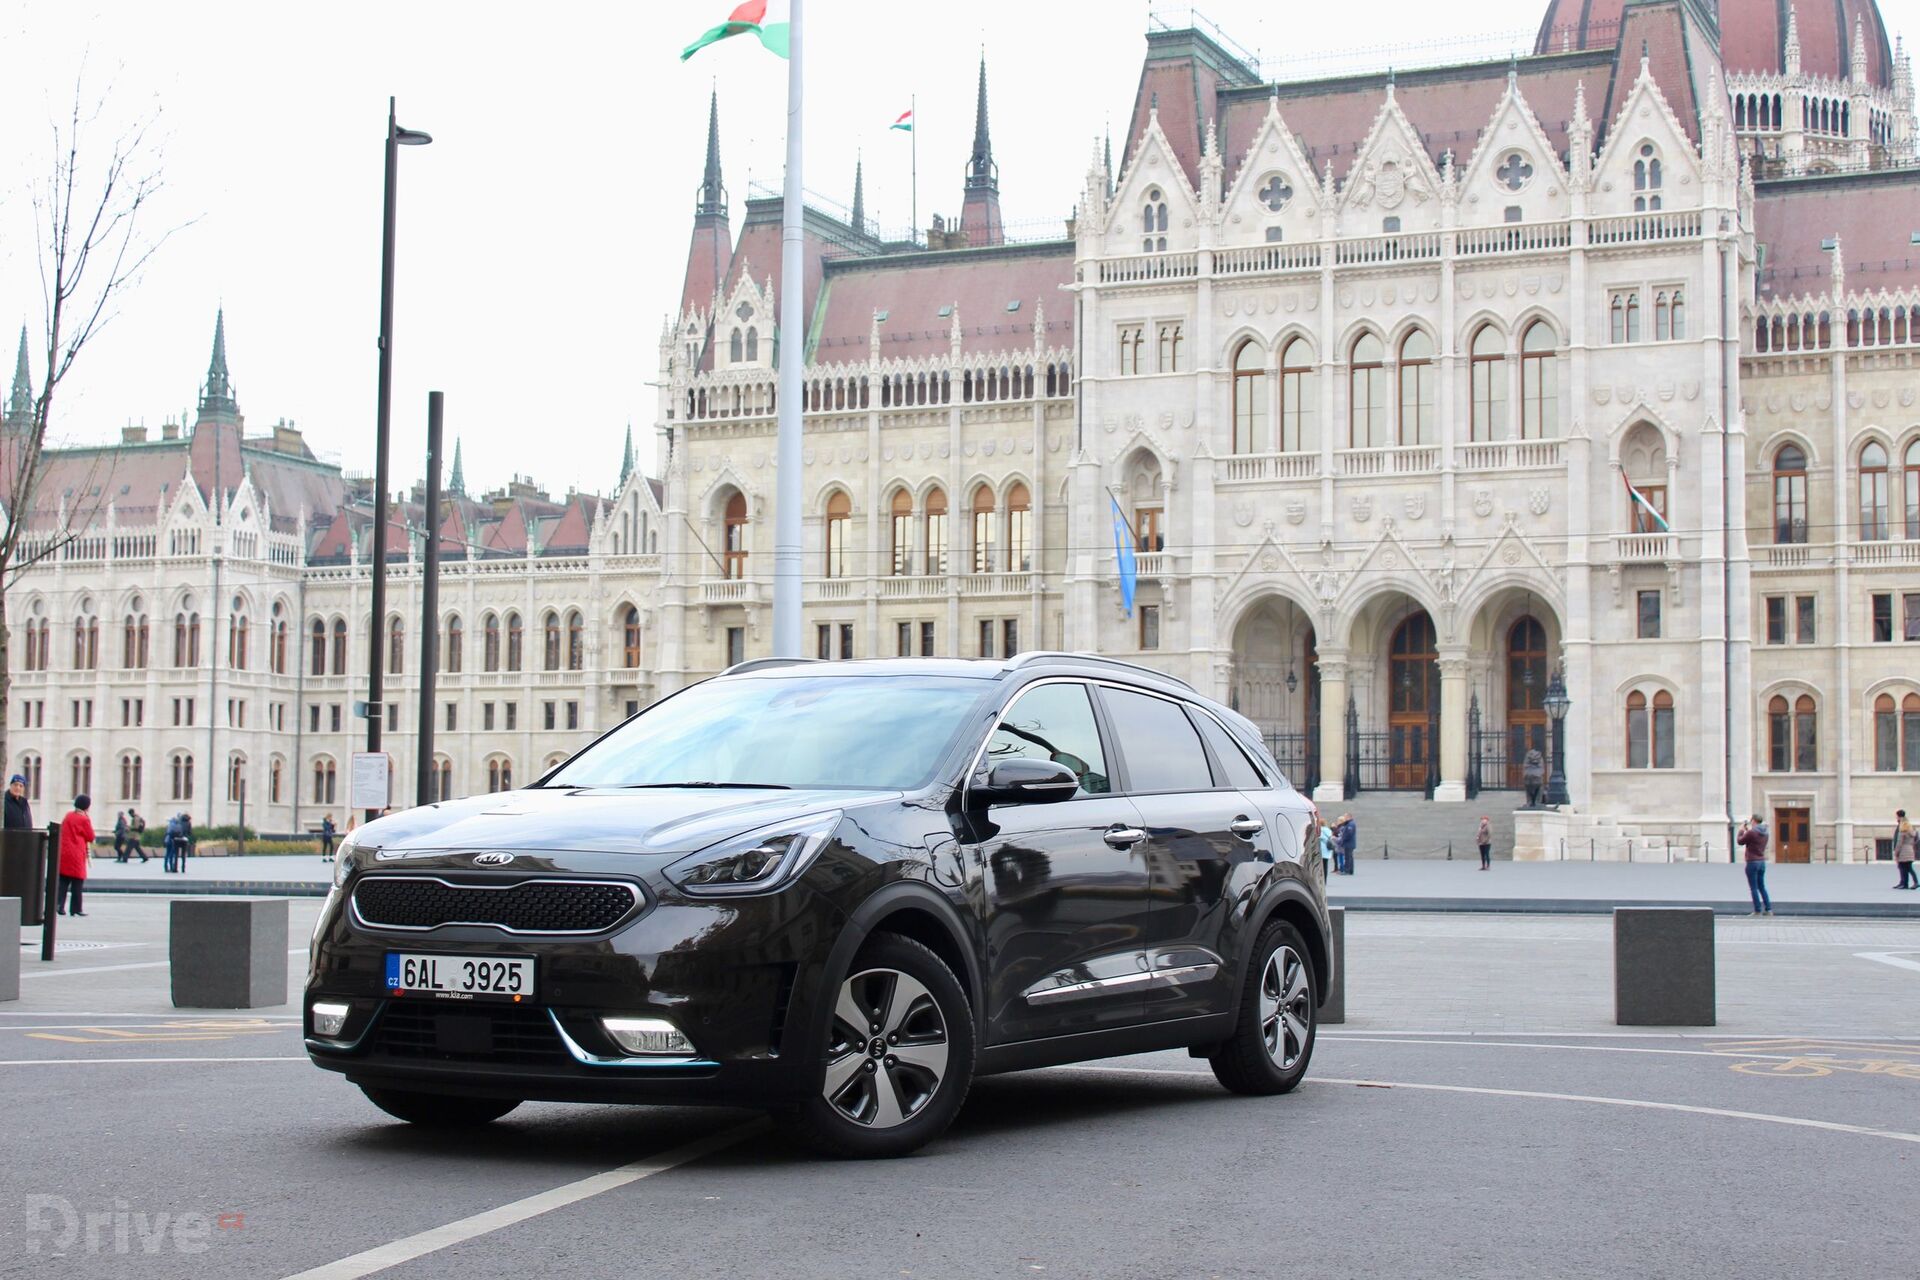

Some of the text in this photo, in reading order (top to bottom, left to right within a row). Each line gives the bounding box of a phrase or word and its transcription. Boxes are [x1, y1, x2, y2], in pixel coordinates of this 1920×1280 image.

[404, 958, 522, 992] 6AL 3925
[387, 977, 399, 987] CZ
[435, 991, 474, 1000] www.kia.com
